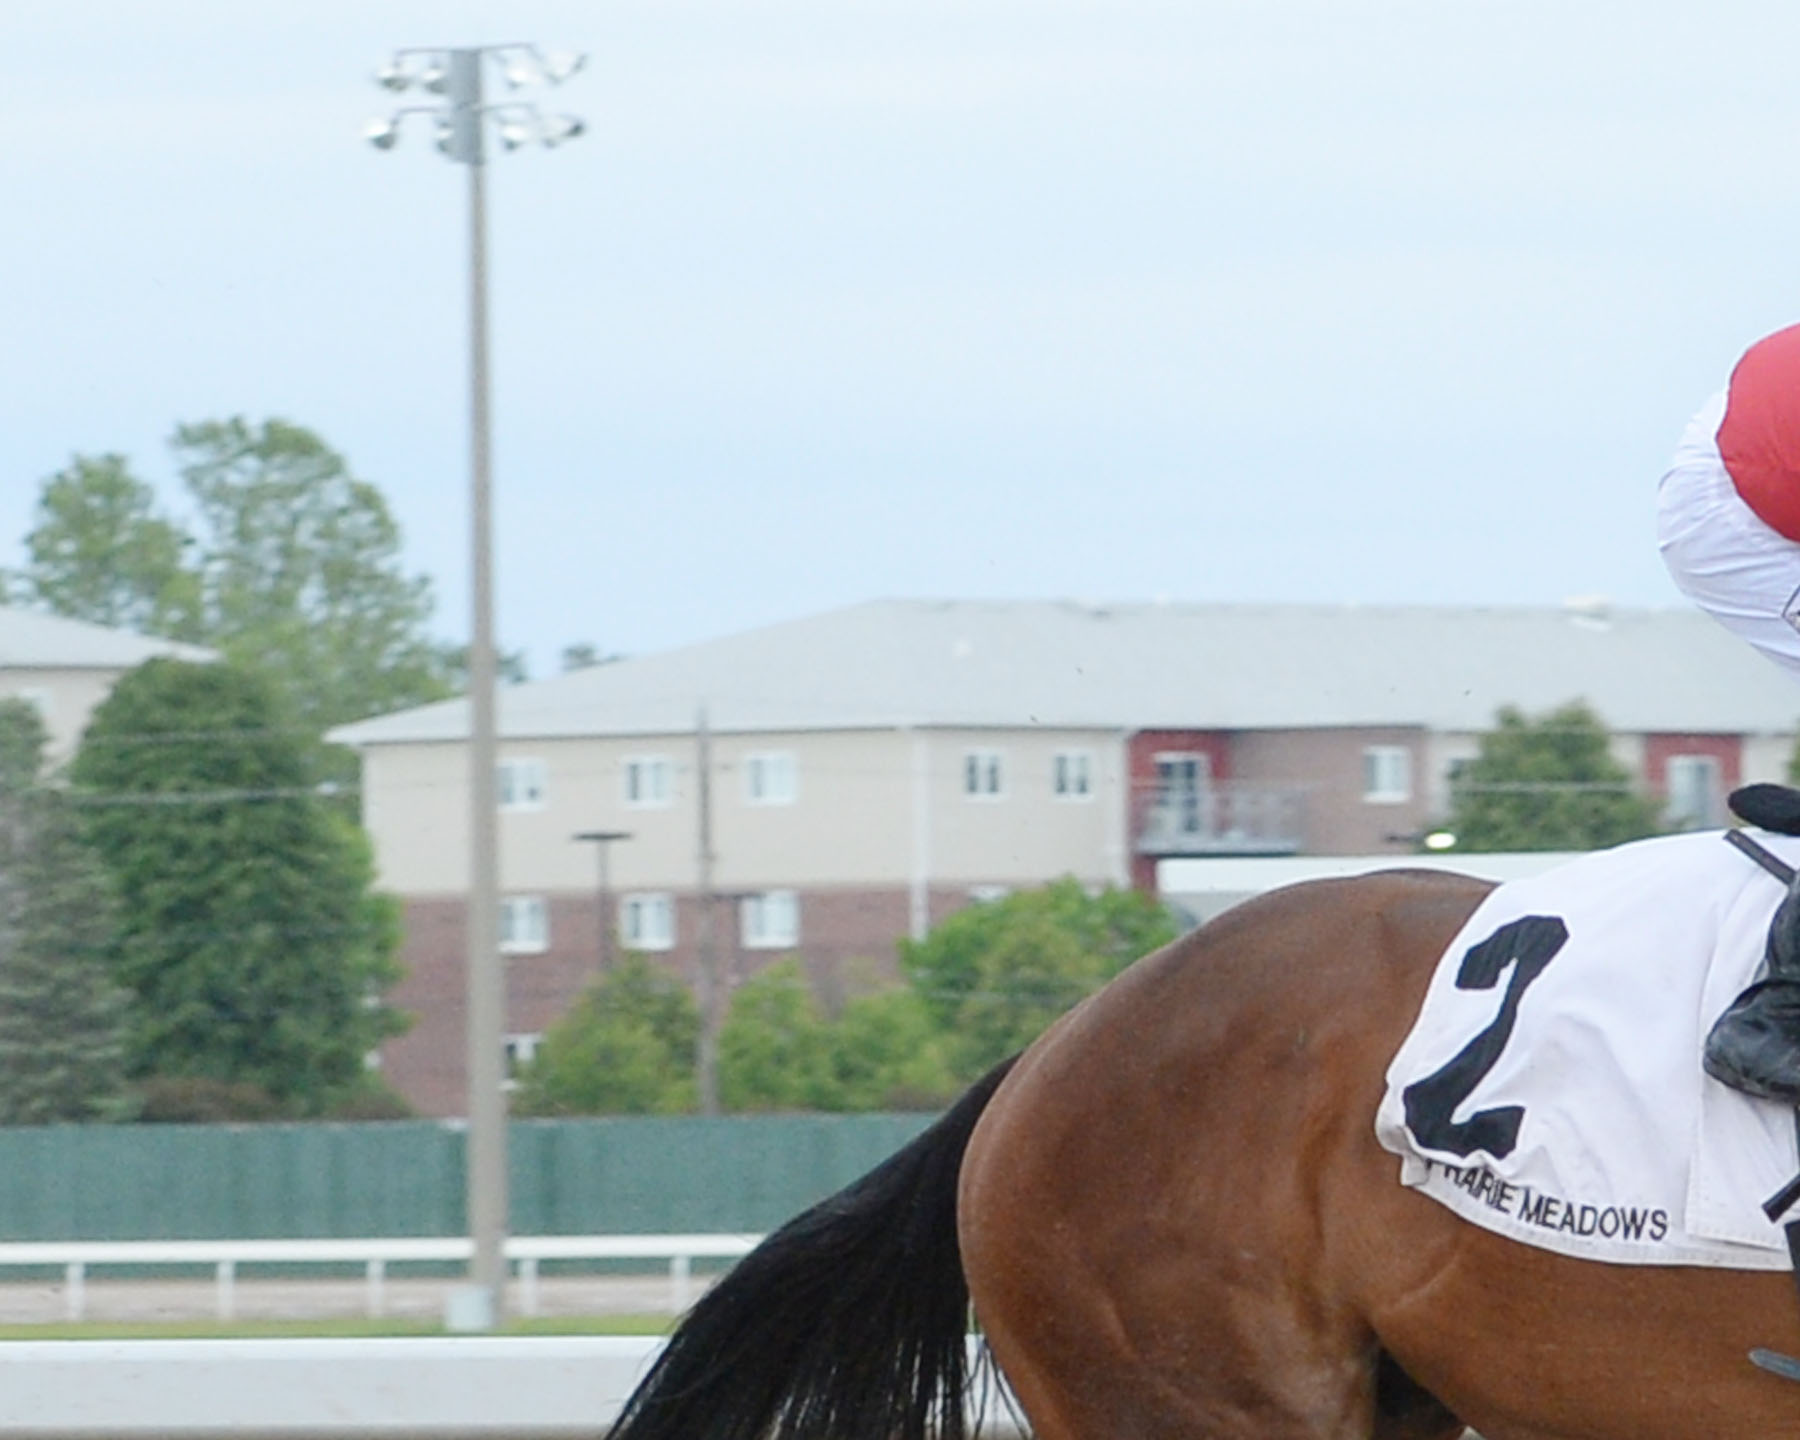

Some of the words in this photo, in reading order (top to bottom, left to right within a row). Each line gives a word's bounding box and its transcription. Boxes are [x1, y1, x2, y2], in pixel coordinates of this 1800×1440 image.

[1402, 914, 1570, 1160] 2
[1424, 1157, 1520, 1214] RAIRIE
[1517, 1186, 1669, 1241] MEADOWS
